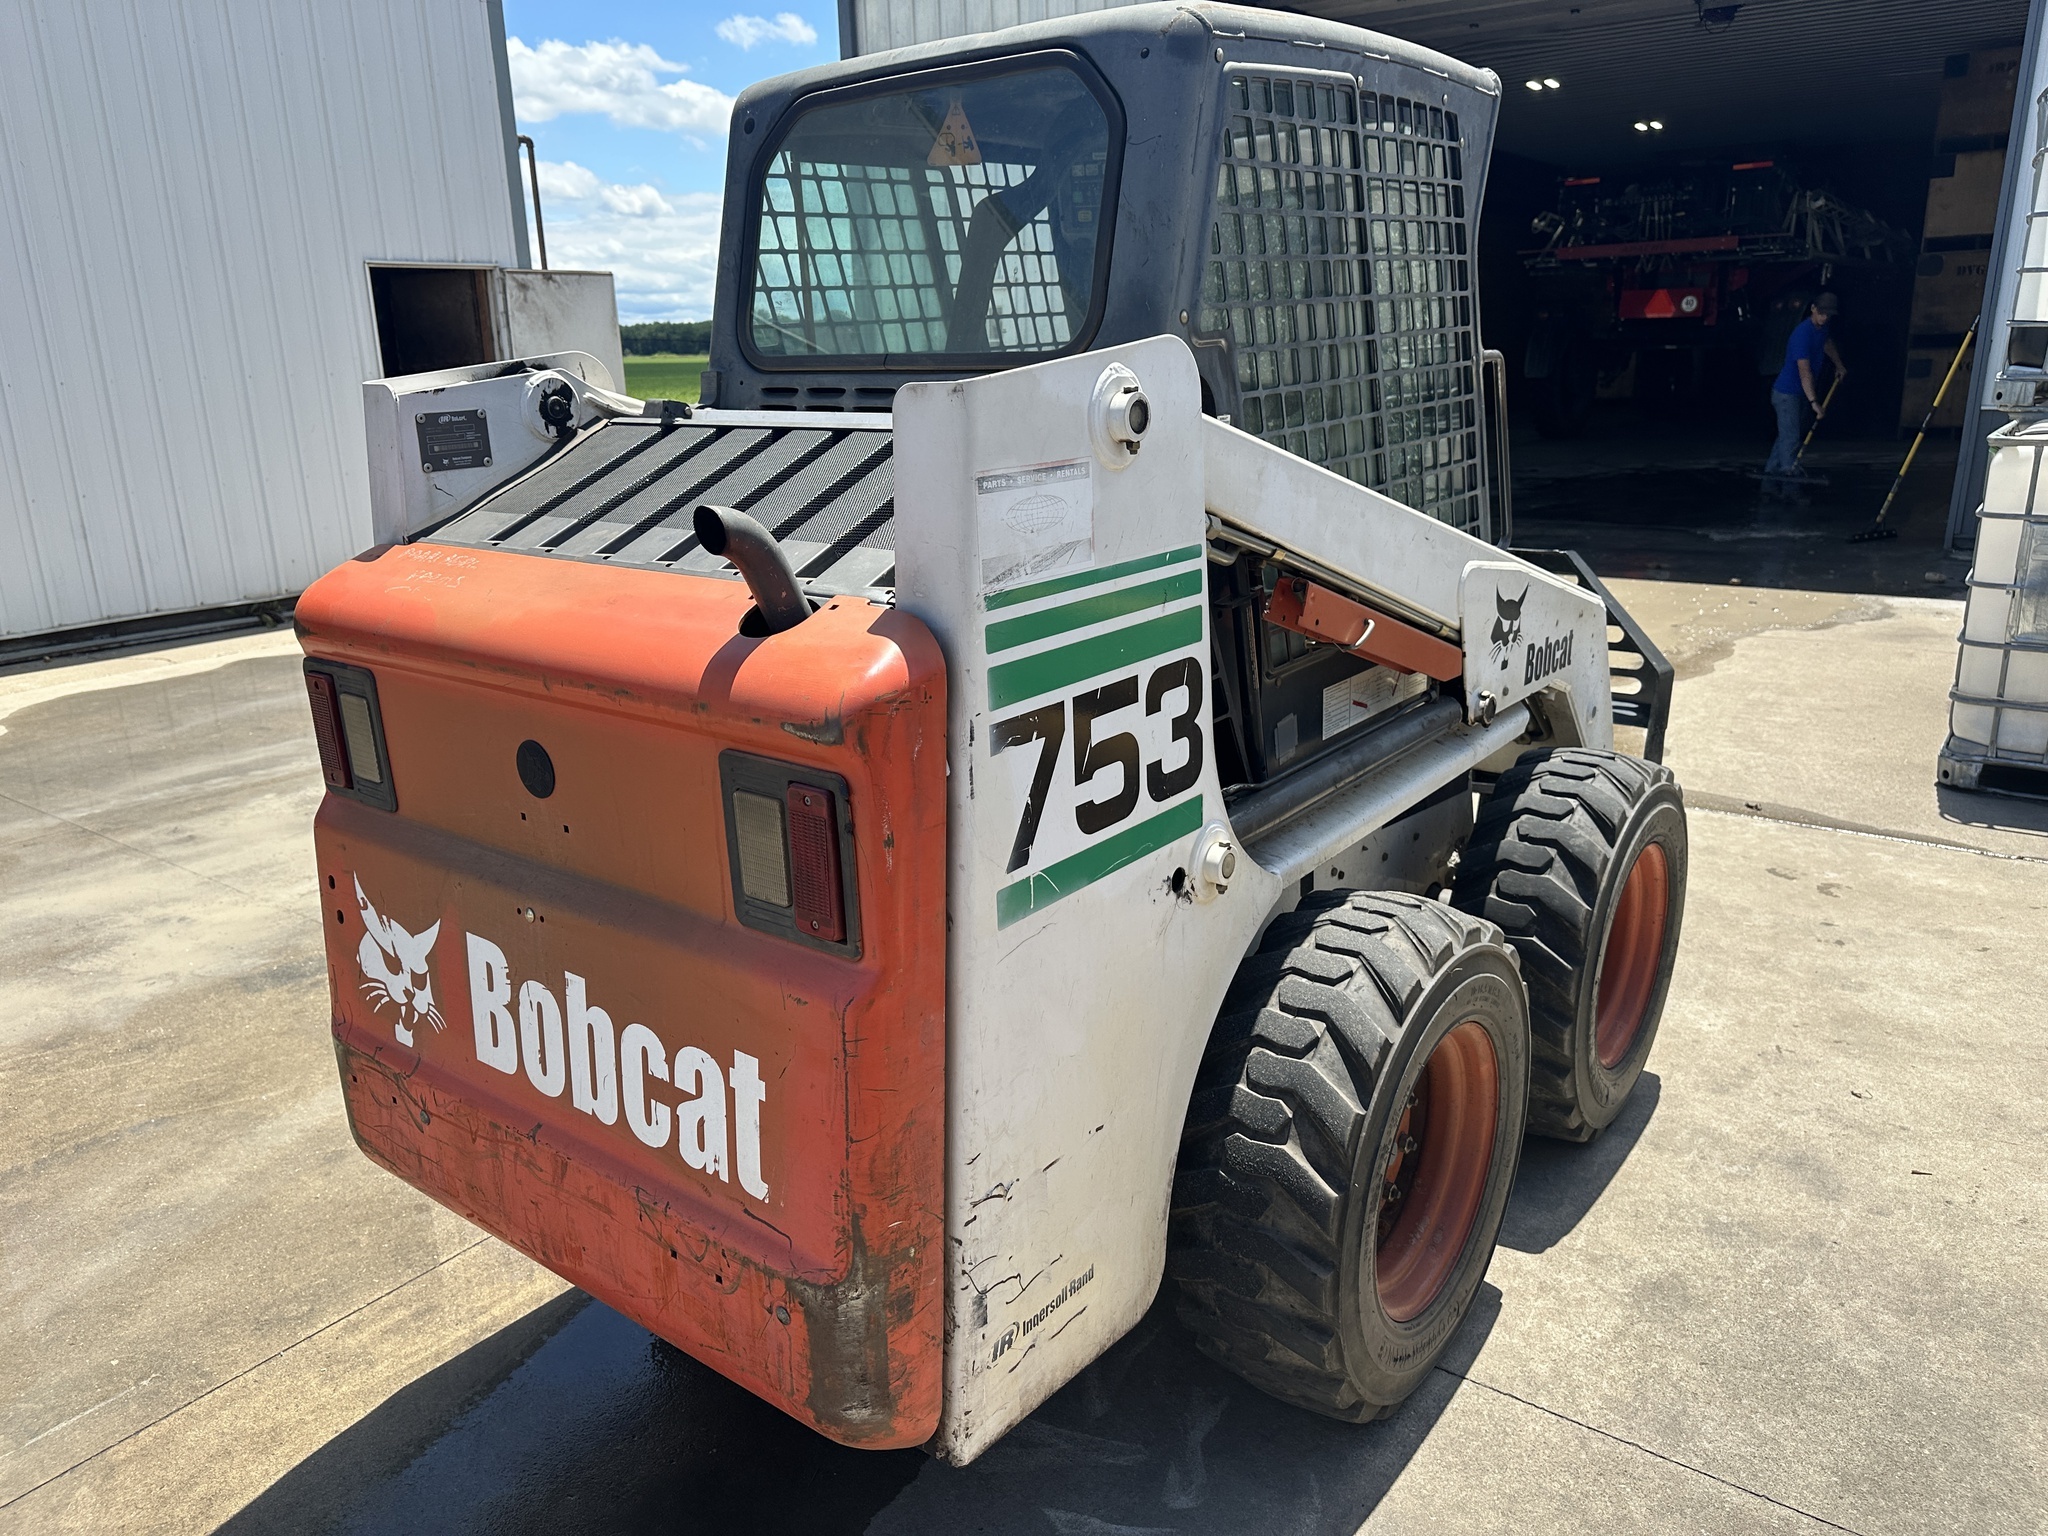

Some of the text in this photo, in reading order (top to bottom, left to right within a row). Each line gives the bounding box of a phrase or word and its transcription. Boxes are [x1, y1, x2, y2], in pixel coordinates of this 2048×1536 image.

[983, 467, 1086, 489] PARTS SERVICE RENTALS
[1524, 629, 1574, 686] Bobcat
[989, 657, 1203, 874] 753
[466, 932, 769, 1203] Bobcat
